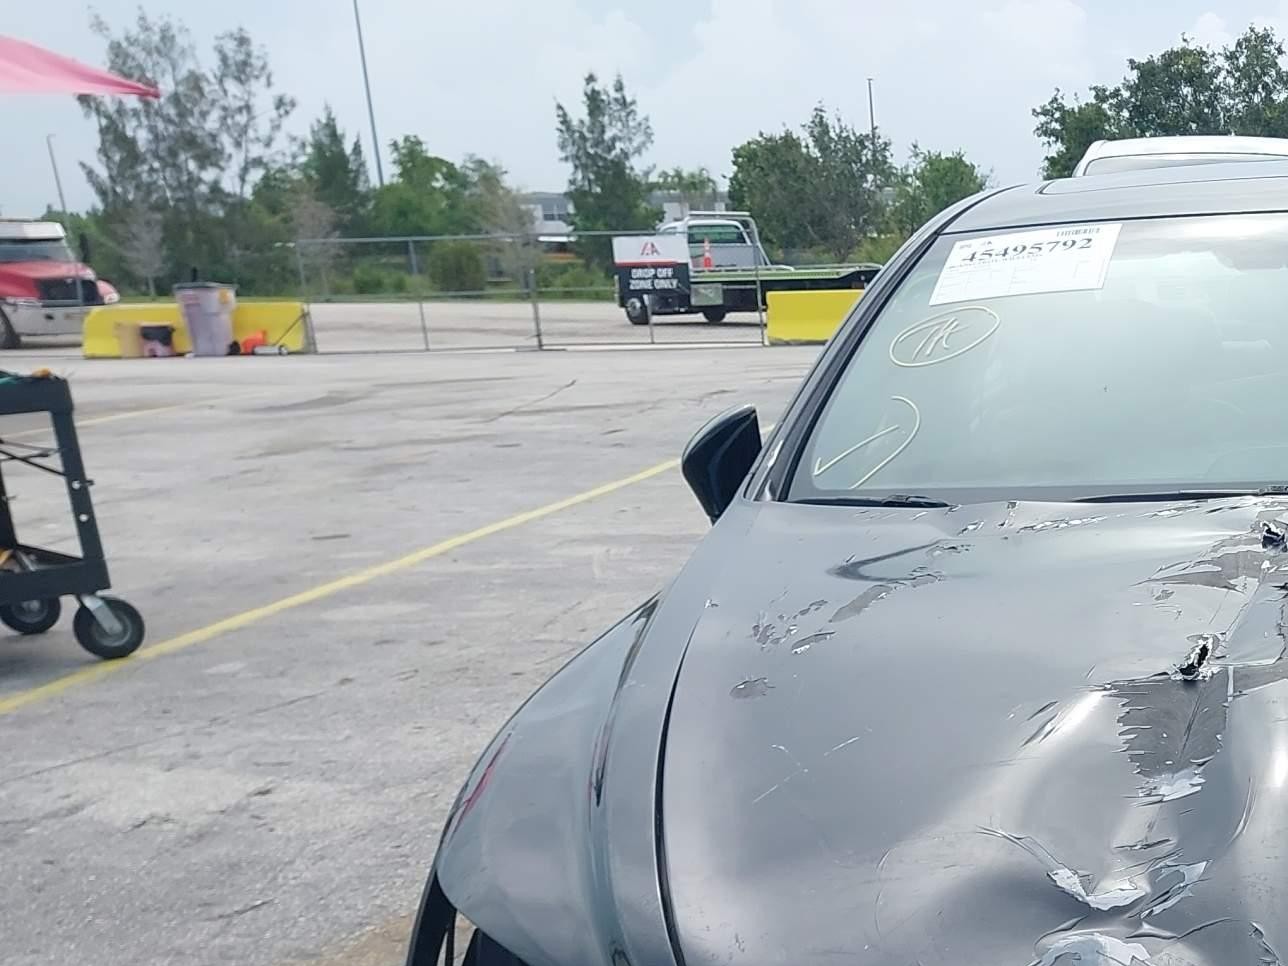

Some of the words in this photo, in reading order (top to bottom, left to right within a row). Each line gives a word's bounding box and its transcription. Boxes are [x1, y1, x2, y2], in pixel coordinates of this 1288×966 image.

[962, 238, 1092, 262] 45495792
[631, 268, 655, 279] DROP
[656, 268, 673, 278] OFF
[629, 279, 653, 290] ZONE
[653, 278, 678, 290] ONLY
